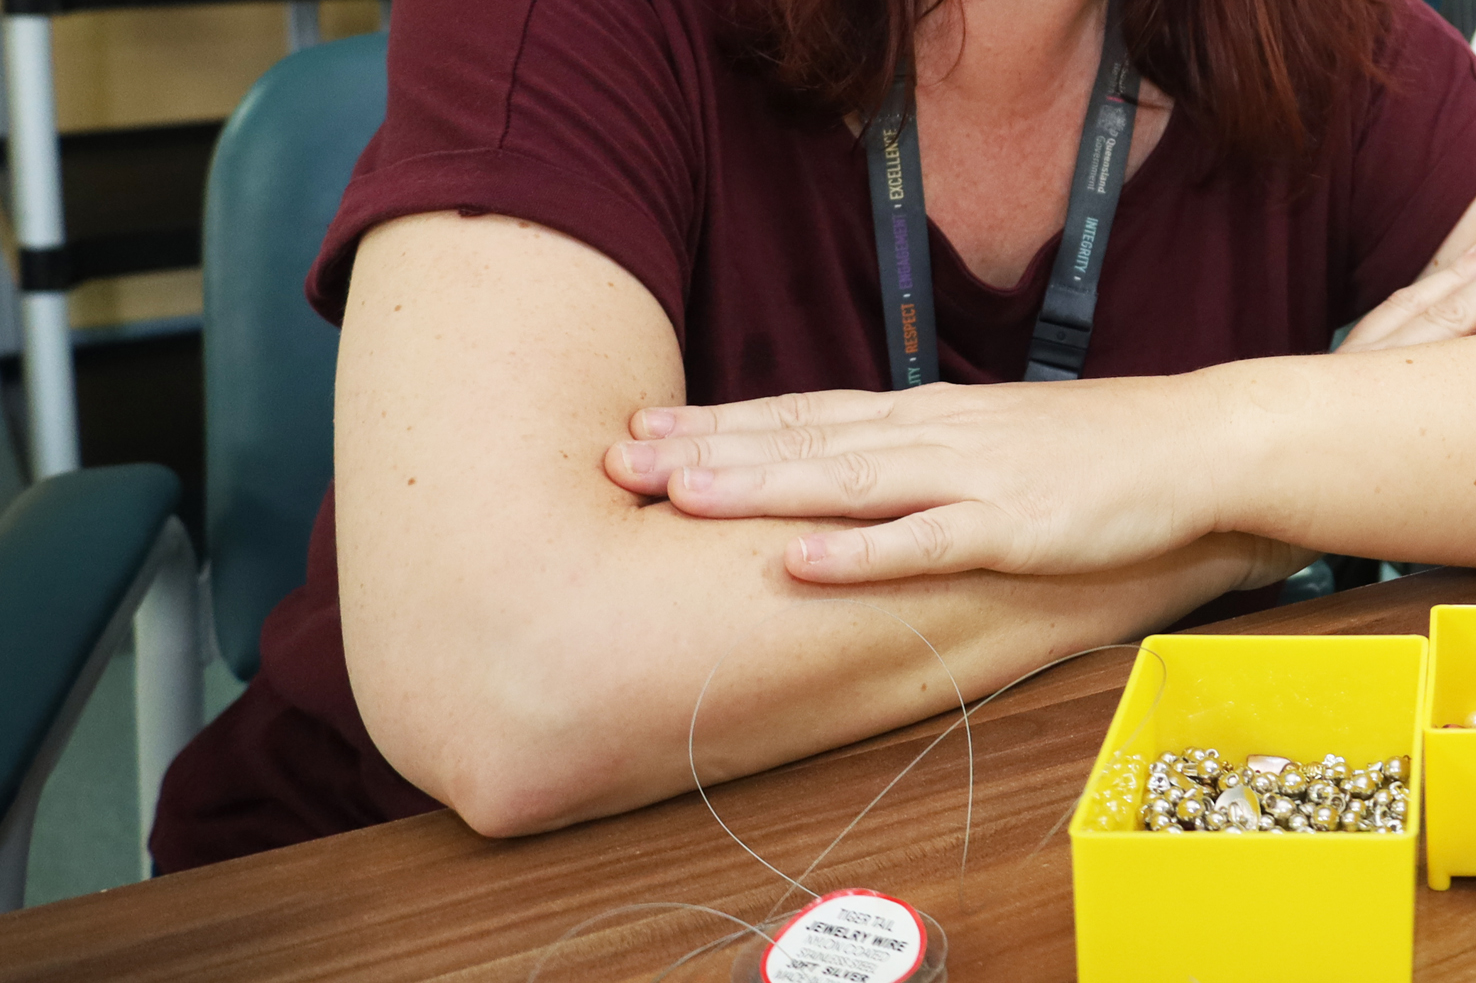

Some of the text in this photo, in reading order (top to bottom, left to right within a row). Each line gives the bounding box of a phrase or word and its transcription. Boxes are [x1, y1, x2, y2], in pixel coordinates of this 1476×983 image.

[1087, 135, 1107, 190] Government
[1097, 138, 1117, 194] Queensland
[883, 128, 922, 387] ITY RESPECT ENGAGEMENT EXCELLENCE
[1075, 217, 1099, 273] INTEGRITY
[805, 920, 909, 953] JEWELRY WIRE
[837, 907, 896, 932] TIGER TAIL
[803, 934, 892, 962] NYLON COATED
[786, 958, 820, 973] SOFT
[822, 965, 871, 983] SILVER
